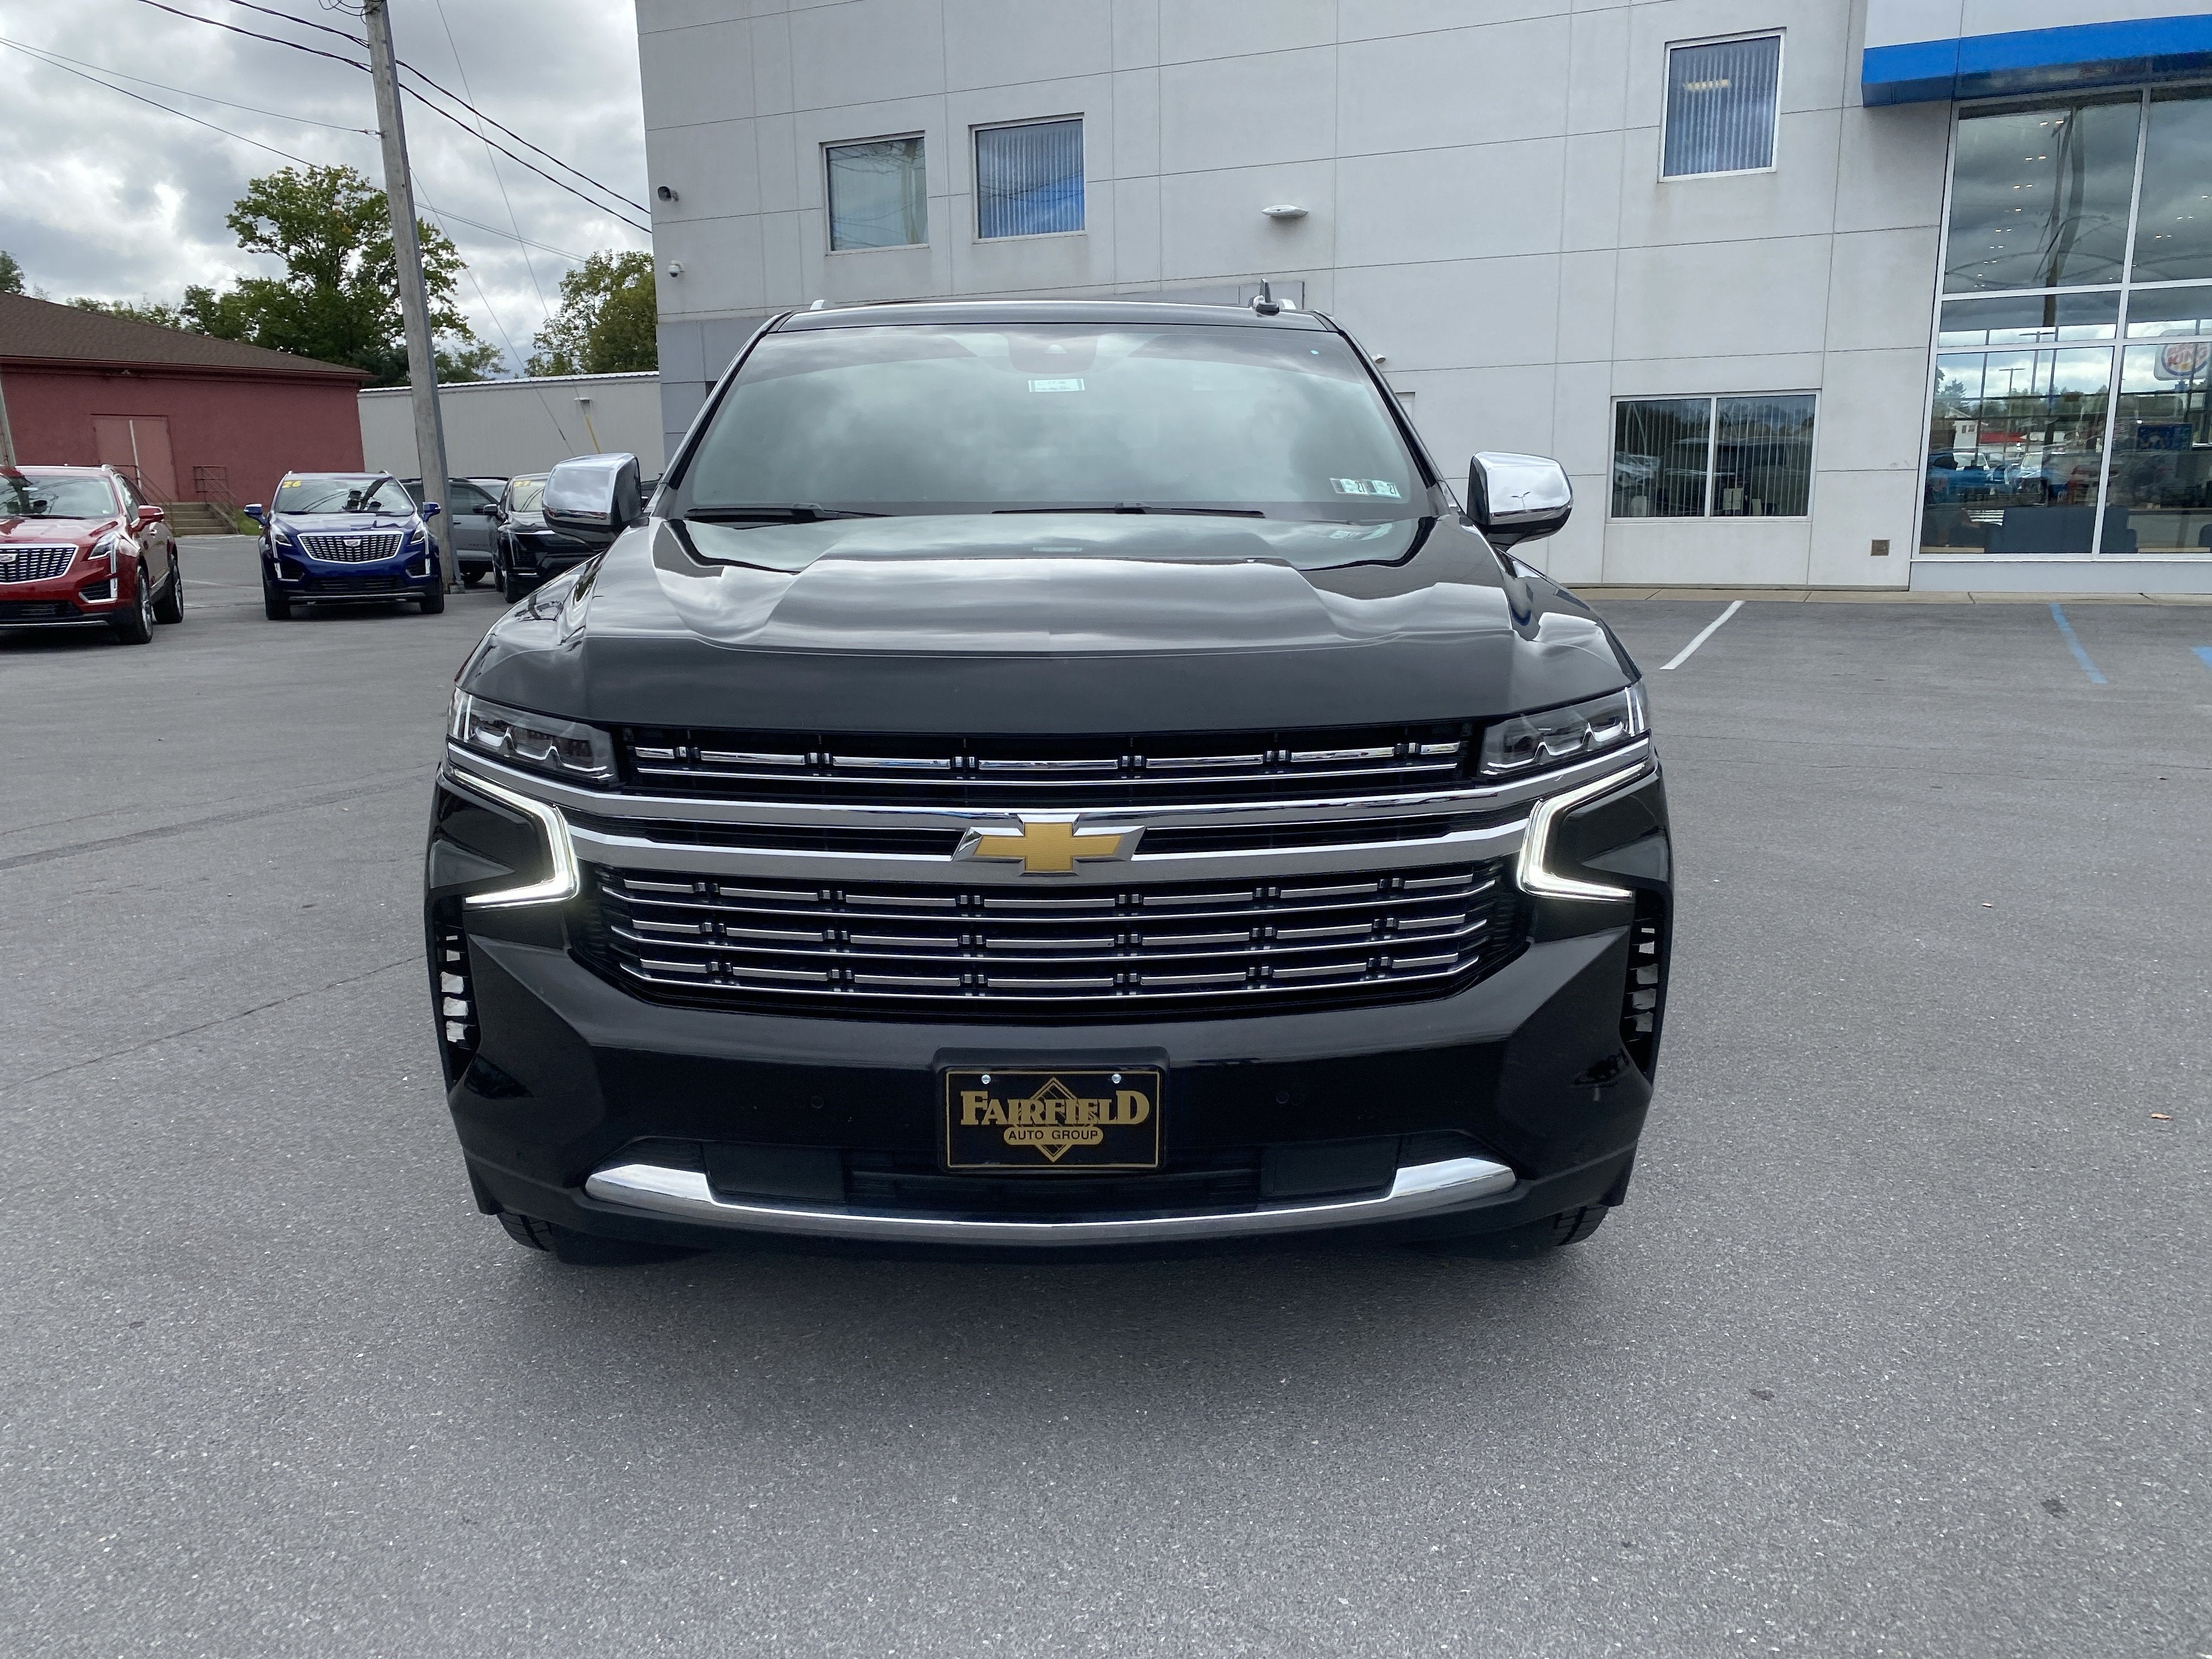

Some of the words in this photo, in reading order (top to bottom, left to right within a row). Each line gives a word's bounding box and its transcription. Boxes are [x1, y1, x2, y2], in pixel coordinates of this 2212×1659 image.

[961, 1090, 1150, 1125] FAIRFIELD
[1008, 1130, 1045, 1140] AUTO
[1052, 1130, 1099, 1140] GROUP
